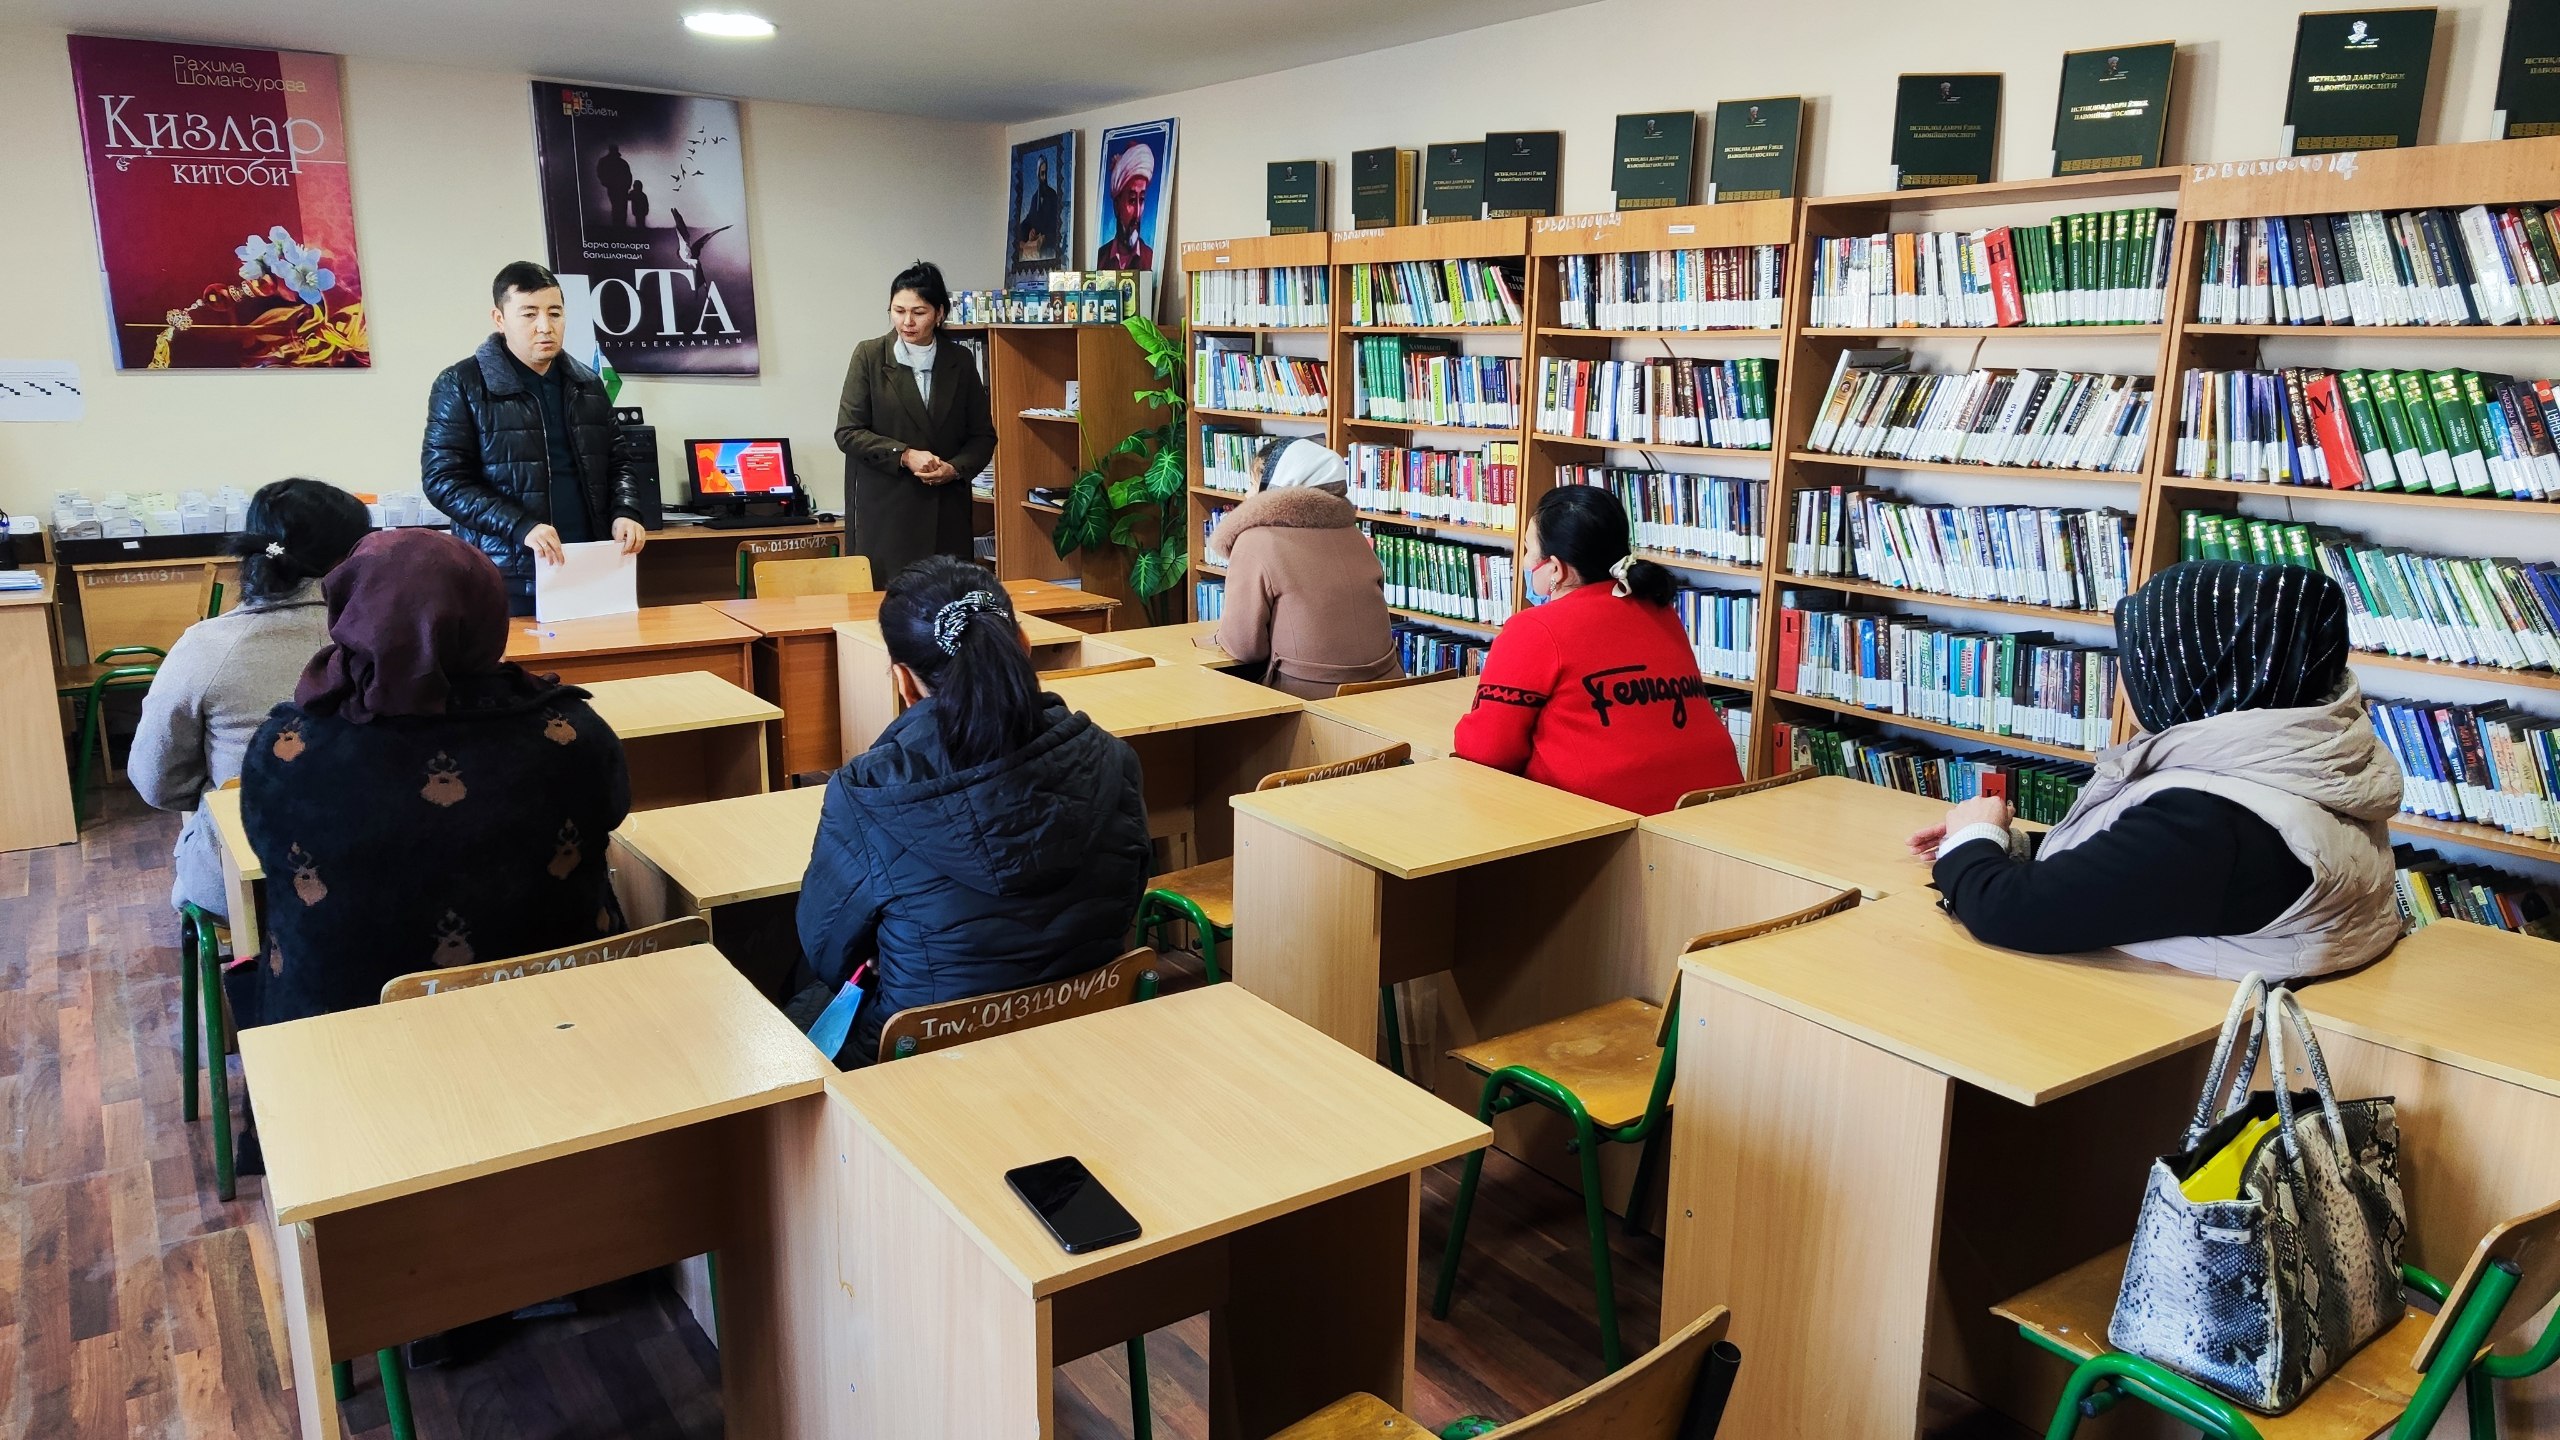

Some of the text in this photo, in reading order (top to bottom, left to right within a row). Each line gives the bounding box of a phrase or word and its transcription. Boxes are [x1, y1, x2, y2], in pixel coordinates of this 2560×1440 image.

[172, 54, 247, 76] Рахима
[173, 68, 307, 93] Шомансурова
[1987, 240, 2008, 265] H
[2310, 390, 2339, 419] M
[1581, 663, 1710, 730] Ferragam
